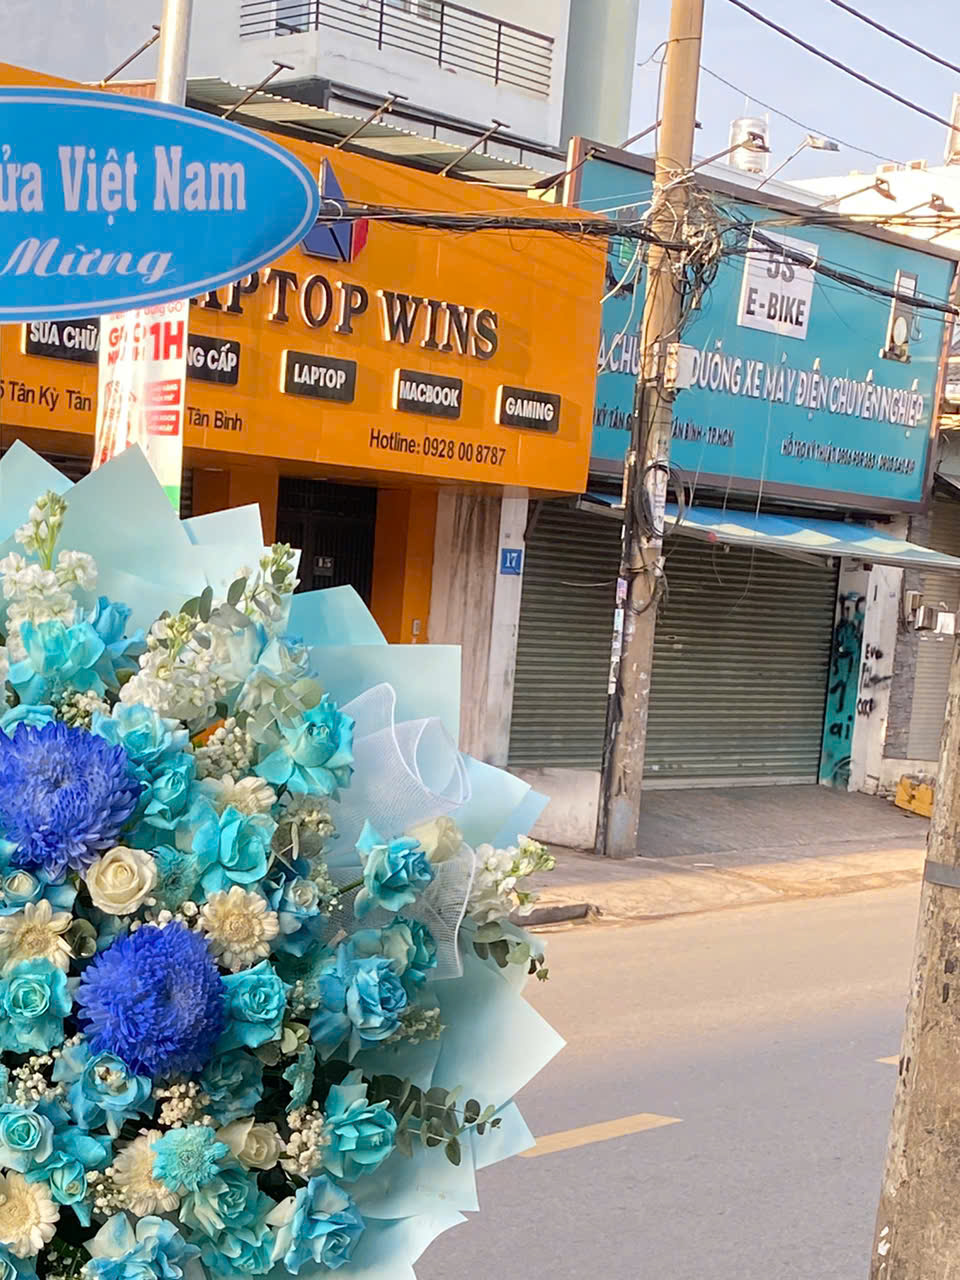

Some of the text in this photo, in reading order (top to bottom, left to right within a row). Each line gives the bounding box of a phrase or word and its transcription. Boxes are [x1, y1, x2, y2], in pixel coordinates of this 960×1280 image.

[57, 145, 138, 226] Việt
[153, 145, 246, 211] Nam
[190, 267, 498, 360] PTOP WINS
[63, 325, 100, 352] CHỮ
[150, 321, 184, 361] 1H
[207, 343, 238, 372] CẤP
[293, 363, 346, 390] LAPTOP
[742, 359, 765, 398] XE
[764, 352, 797, 404] MÁY
[8, 381, 35, 405] Tân
[38, 386, 59, 412] Kỳ
[66, 389, 91, 412] Tân
[187, 407, 210, 428] Tân
[214, 410, 243, 433] Bình
[399, 380, 459, 408] MACBOOK
[505, 397, 554, 422] GAMING
[369, 428, 507, 466] Hotline: 0928 00 8787
[505, 552, 518, 567] 17
